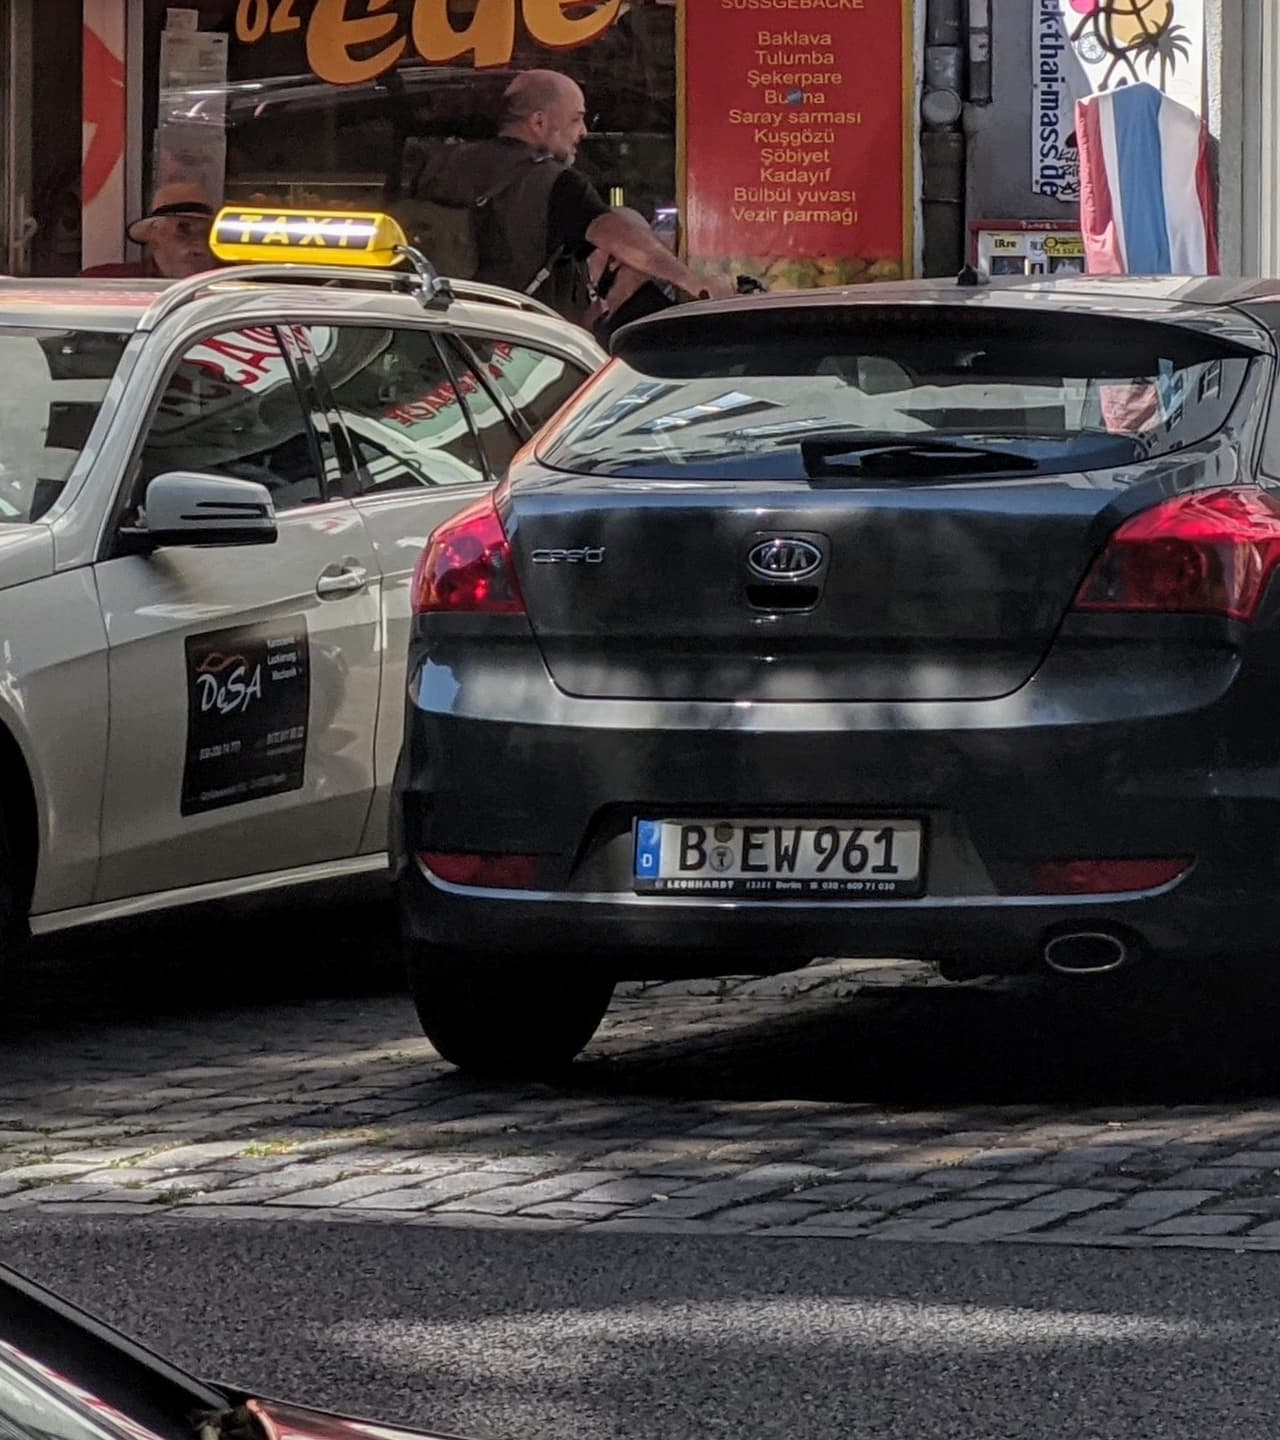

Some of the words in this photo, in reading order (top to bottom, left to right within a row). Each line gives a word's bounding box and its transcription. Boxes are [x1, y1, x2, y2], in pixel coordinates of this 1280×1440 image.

[758, 30, 832, 46] Baklava
[755, 50, 835, 65] Tulumba
[747, 71, 842, 88] Şekerpare
[729, 110, 782, 127] Saray
[788, 112, 862, 125] sarması
[754, 129, 835, 145] Kuşgözü
[760, 167, 832, 186] Kadayıf
[734, 187, 791, 203] Bülbül
[797, 190, 856, 206] yuvası
[732, 207, 777, 223] Vezir
[783, 208, 858, 225] parmağı
[239, 214, 354, 247] TAXI
[761, 547, 808, 568] KIA
[642, 853, 653, 867] D
[679, 825, 707, 871] B
[741, 826, 801, 873] EW
[814, 825, 898, 874] 961
